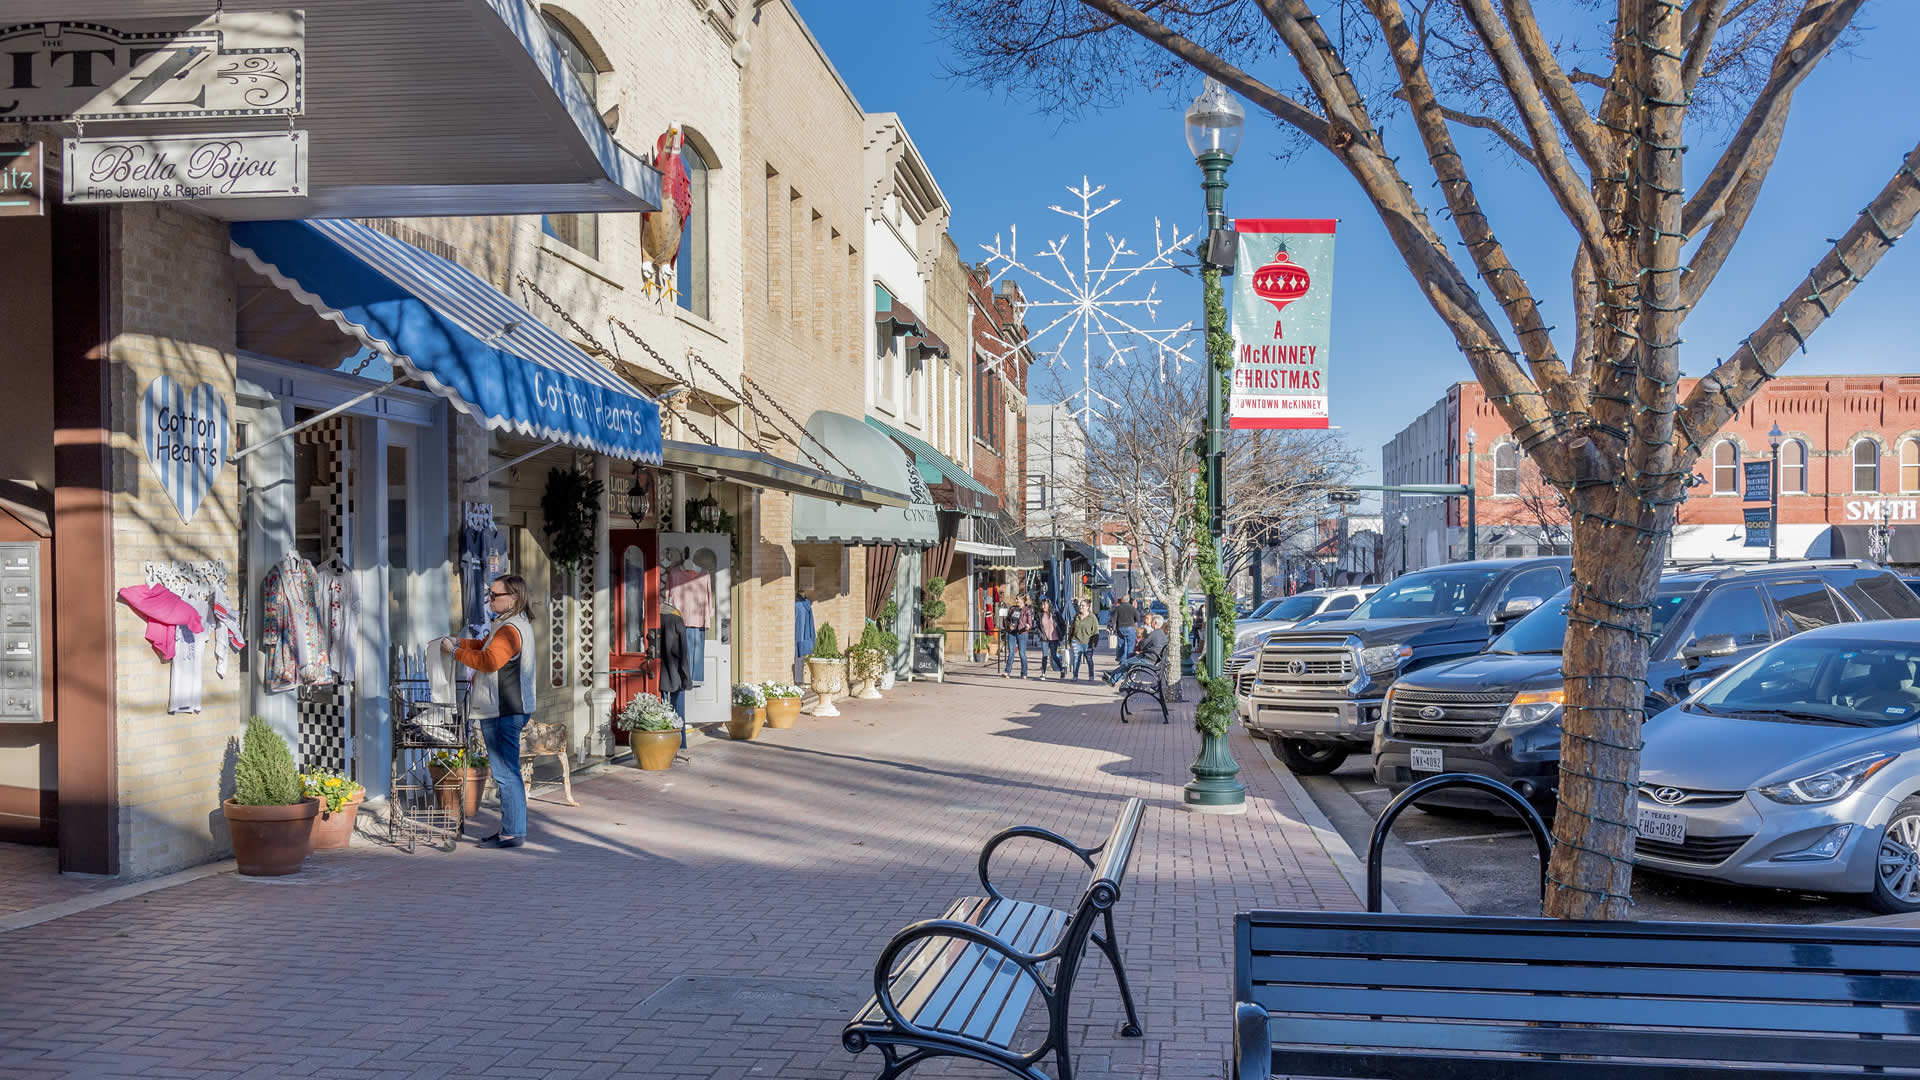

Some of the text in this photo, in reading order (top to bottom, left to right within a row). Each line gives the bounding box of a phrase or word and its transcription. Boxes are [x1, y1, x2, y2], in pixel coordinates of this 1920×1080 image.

[0, 46, 207, 113] ITZ
[89, 140, 276, 194] Bella Bijou
[0, 167, 33, 192] itz
[87, 184, 213, 200] Fine Jewelry & Repair
[1274, 320, 1283, 339] A
[1240, 344, 1317, 364] McKINNEY
[1235, 369, 1320, 389] CHRISTMAS
[534, 371, 642, 436] Cotton Hearts
[1282, 399, 1321, 410] McKINNEY
[158, 406, 216, 439] Cotton
[157, 434, 217, 466] Hearts
[1747, 521, 1770, 529] GOOD
[1651, 812, 1671, 820] TEXAS
